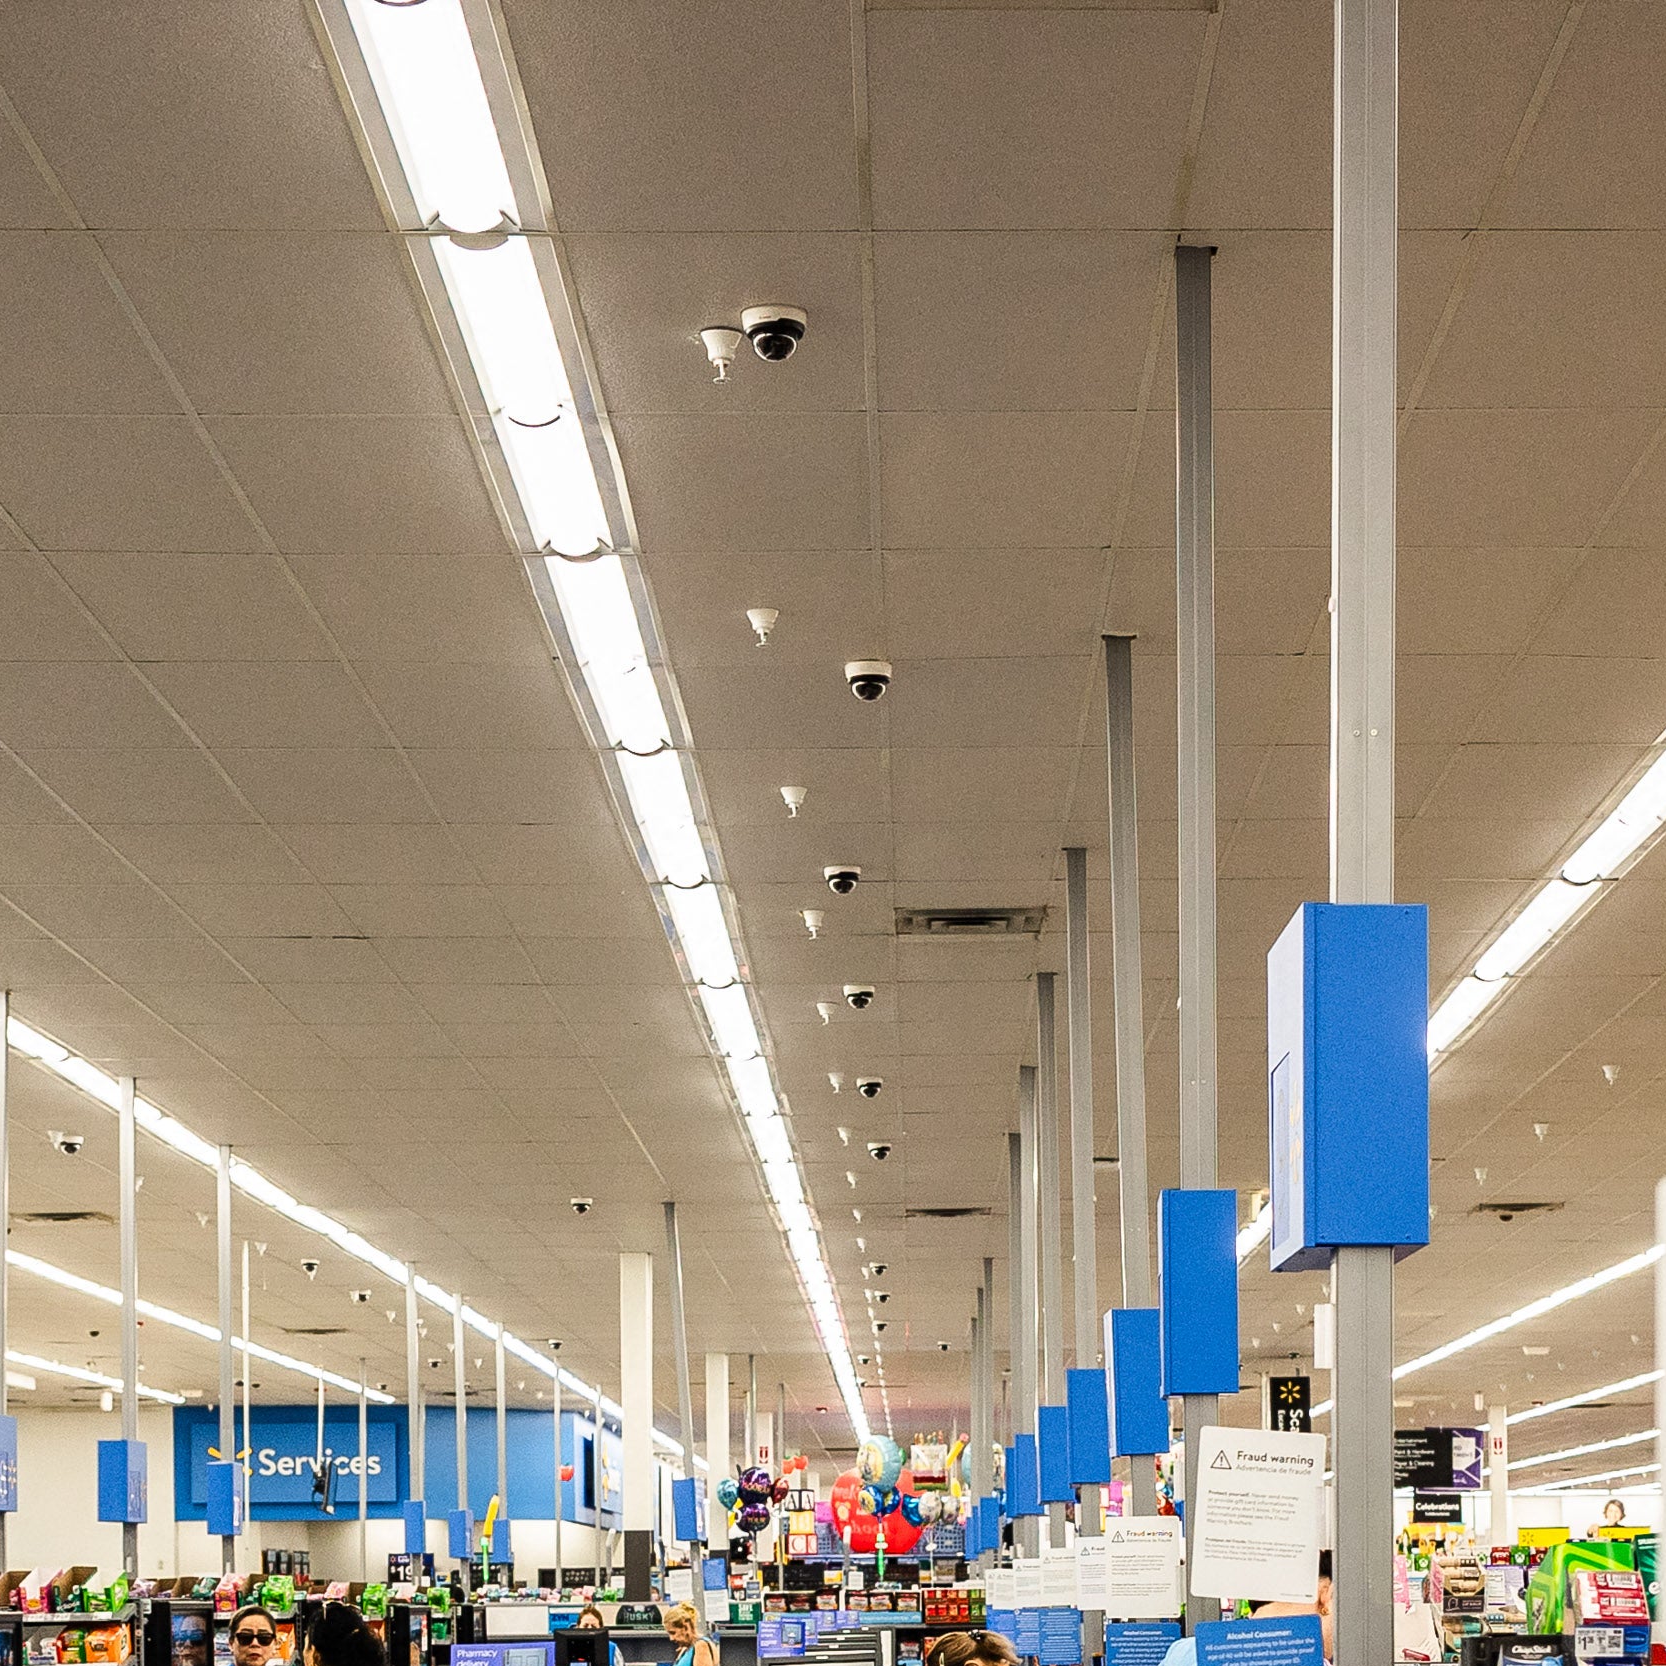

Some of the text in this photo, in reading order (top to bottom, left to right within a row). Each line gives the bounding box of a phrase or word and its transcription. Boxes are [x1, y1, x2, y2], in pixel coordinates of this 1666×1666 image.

[1289, 1408, 1304, 1432] Sca
[258, 1447, 381, 1476] Services
[1237, 1450, 1315, 1468] Fraud warning
[1235, 1464, 1277, 1474] Advertencia
[1289, 1467, 1311, 1475] fraude
[1416, 1502, 1460, 1511] Celebrations
[1147, 1530, 1173, 1538] warning
[624, 1611, 655, 1622] HUSKY
[1226, 1631, 1253, 1641] Alcohol
[1511, 1644, 1551, 1654] ChapStick
[456, 1650, 498, 1660] Pharmacy
